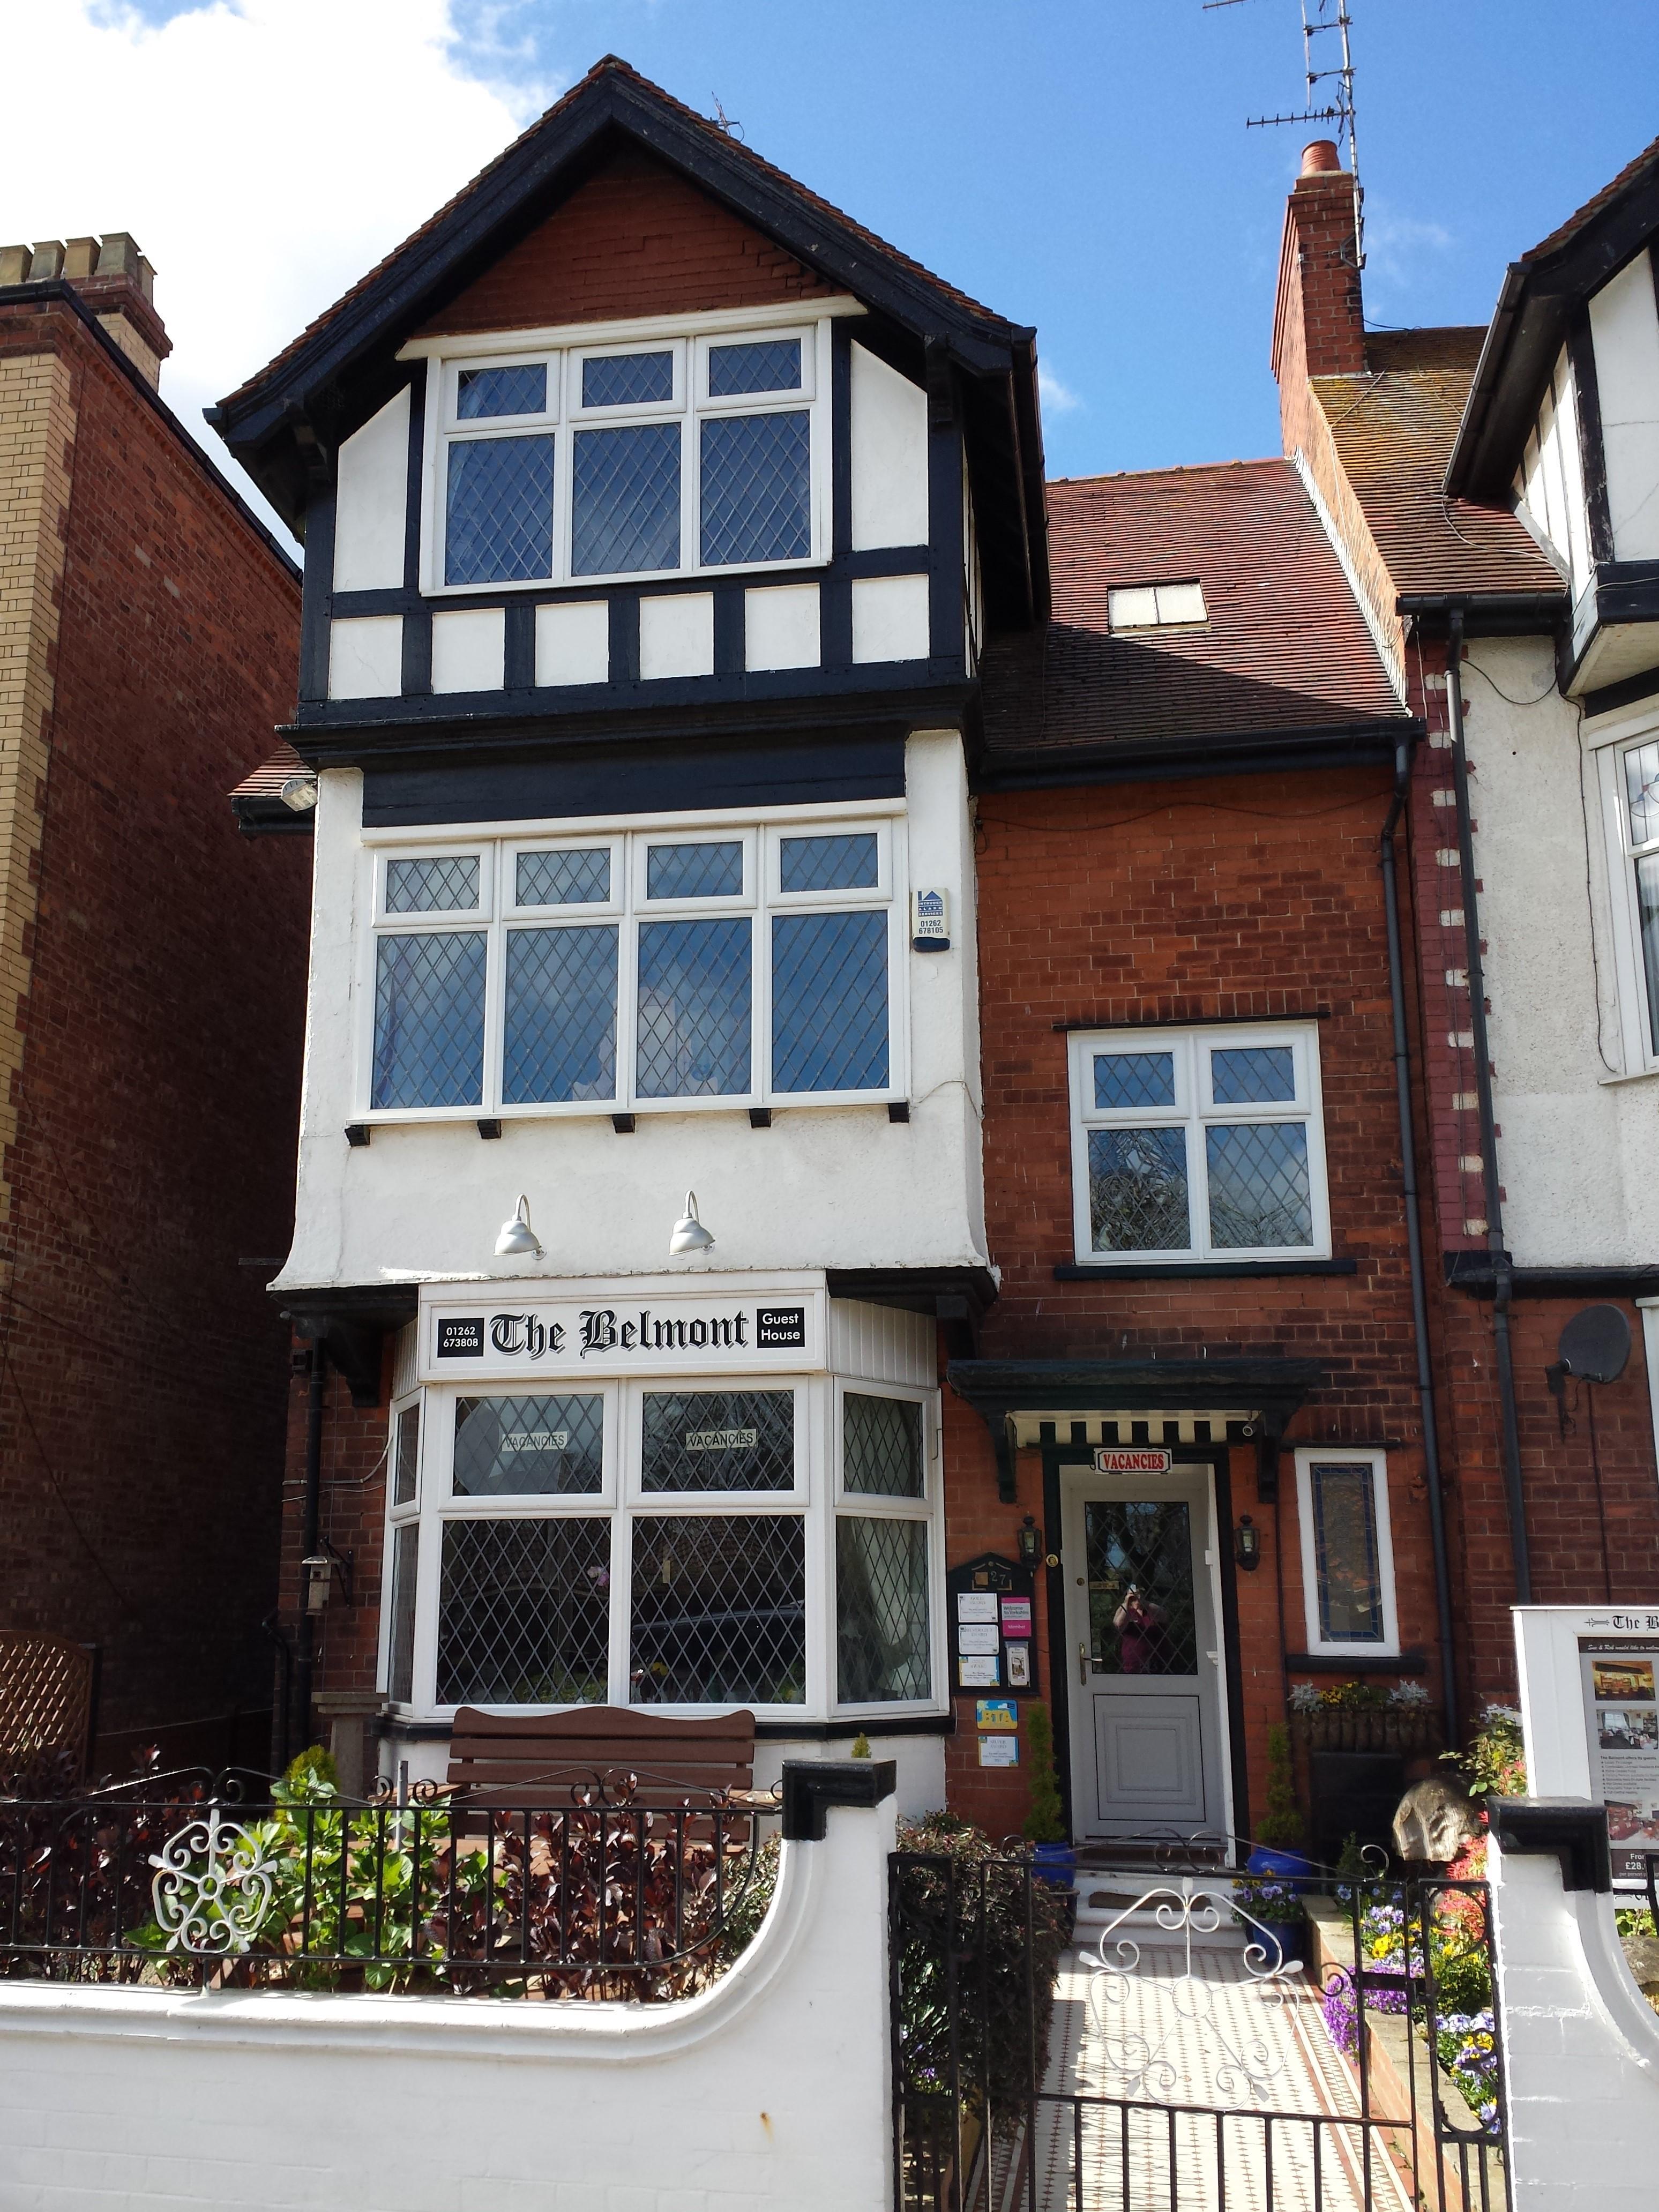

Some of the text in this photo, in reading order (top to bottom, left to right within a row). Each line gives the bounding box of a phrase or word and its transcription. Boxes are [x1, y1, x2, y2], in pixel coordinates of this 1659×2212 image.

[762, 1313, 799, 1325] Guest
[446, 1326, 476, 1336] 01262
[489, 1310, 749, 1361] The Belmont
[761, 1329, 801, 1340] House
[443, 1338, 479, 1347] 673808
[506, 1434, 564, 1448] VACANCIES
[690, 1432, 753, 1447] VACANCIES
[1103, 1454, 1164, 1470] VACANCIES
[1611, 1616, 1640, 1631] The
